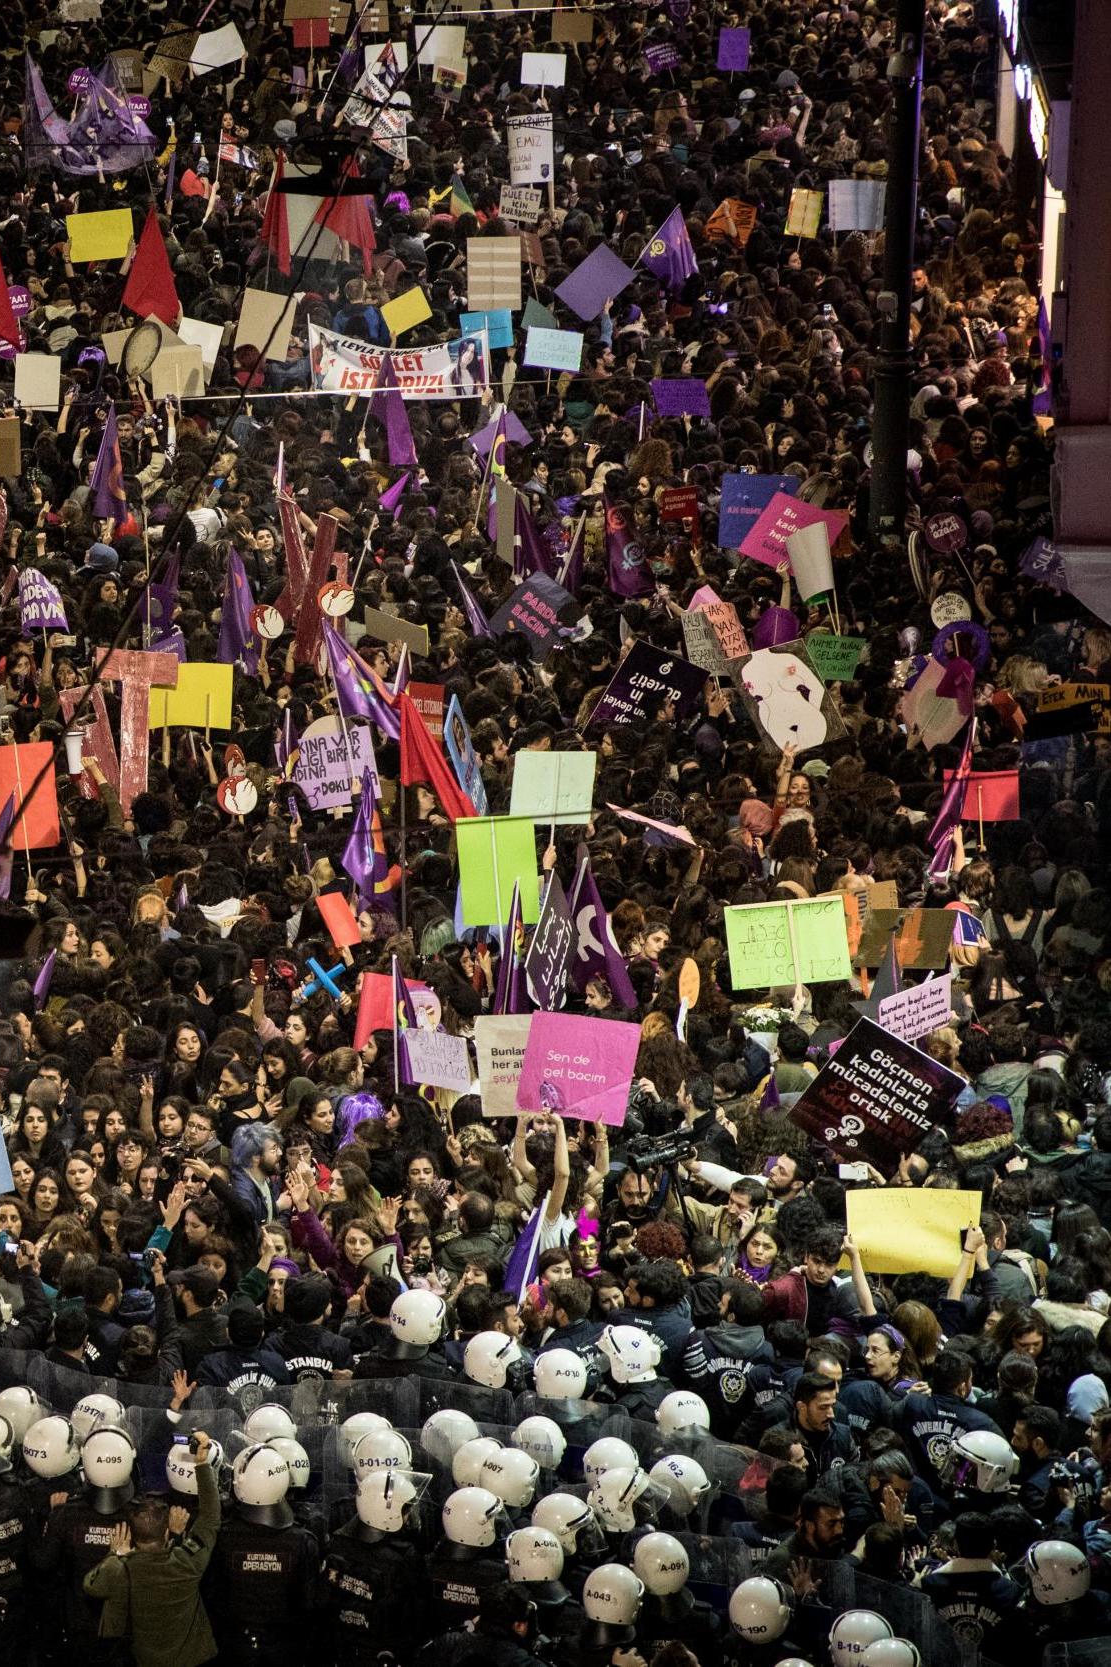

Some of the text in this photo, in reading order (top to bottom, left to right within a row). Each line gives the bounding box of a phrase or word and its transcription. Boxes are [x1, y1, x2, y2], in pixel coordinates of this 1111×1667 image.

[341, 339, 375, 355] LEYLA
[783, 507, 796, 519] Bu
[331, 731, 361, 748] VAR
[492, 1060, 510, 1069] her
[547, 1050, 590, 1066] Sen de
[543, 1065, 564, 1079] gel
[869, 1049, 934, 1096] Göçmen
[849, 1053, 930, 1112] kadınlarla
[828, 1060, 934, 1131] mücadelemiz
[849, 1091, 893, 1125] ortak
[96, 1454, 122, 1465] A-095
[84, 1534, 111, 1546] OPERAS
[247, 1553, 278, 1562] KURTARMA
[243, 1561, 282, 1572] OPERASYON
[446, 1582, 477, 1595] KURTARMA
